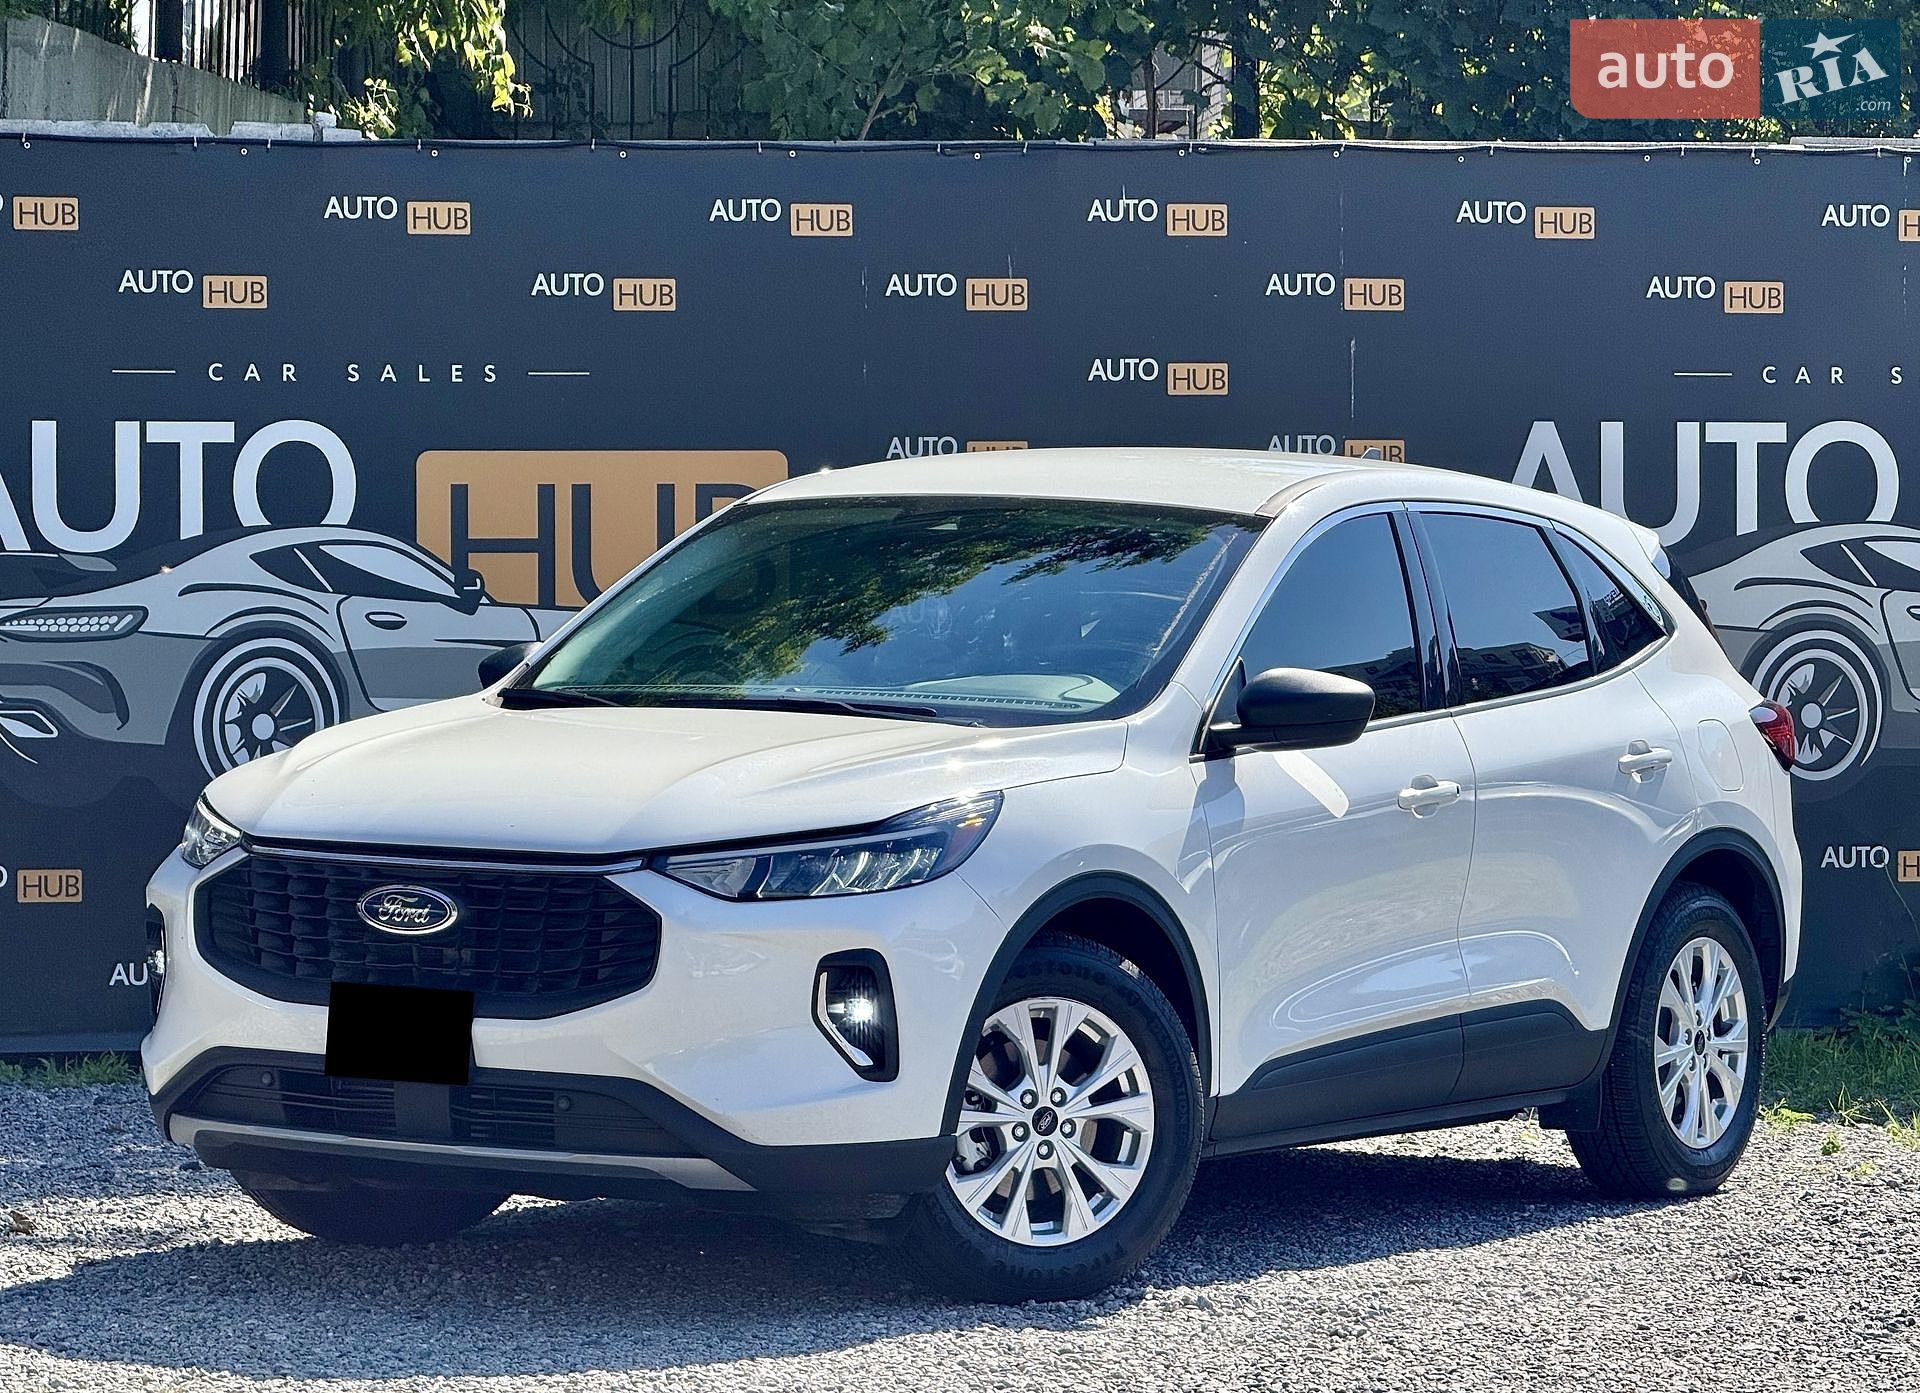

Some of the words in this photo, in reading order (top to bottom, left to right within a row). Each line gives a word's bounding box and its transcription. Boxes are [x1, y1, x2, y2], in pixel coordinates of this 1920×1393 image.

[19, 202, 76, 226] HUB
[324, 196, 398, 220] AUTO
[412, 206, 469, 230] HUB
[710, 198, 782, 222] AUTO
[796, 209, 851, 232] HUB
[1088, 198, 1159, 222] AUTO
[1172, 209, 1226, 232] HUB
[1456, 200, 1527, 224] AUTO
[1540, 212, 1593, 235] HUB
[1821, 204, 1891, 228] AUTO
[118, 269, 194, 294] AUTO
[208, 281, 266, 305] HUB
[531, 273, 604, 297] AUTO
[618, 284, 674, 307] HUB
[885, 274, 957, 297] AUTO
[971, 283, 1026, 307] HUB
[1265, 273, 1336, 296] AUTO
[1350, 284, 1402, 307] HUB
[1646, 276, 1716, 299] AUTO
[1730, 287, 1782, 309] HUB
[208, 363, 297, 383] CAR
[347, 363, 497, 383] SALES
[1088, 358, 1159, 382] AUTO
[1172, 368, 1227, 391] HUB
[1762, 366, 1845, 384] CAR
[886, 436, 958, 459] AUTO
[1268, 434, 1337, 455] AUTO
[1512, 420, 1899, 547] AUTO
[1820, 845, 1890, 869] AUTO
[23, 875, 80, 898] HUB
[379, 894, 432, 923] Ford
